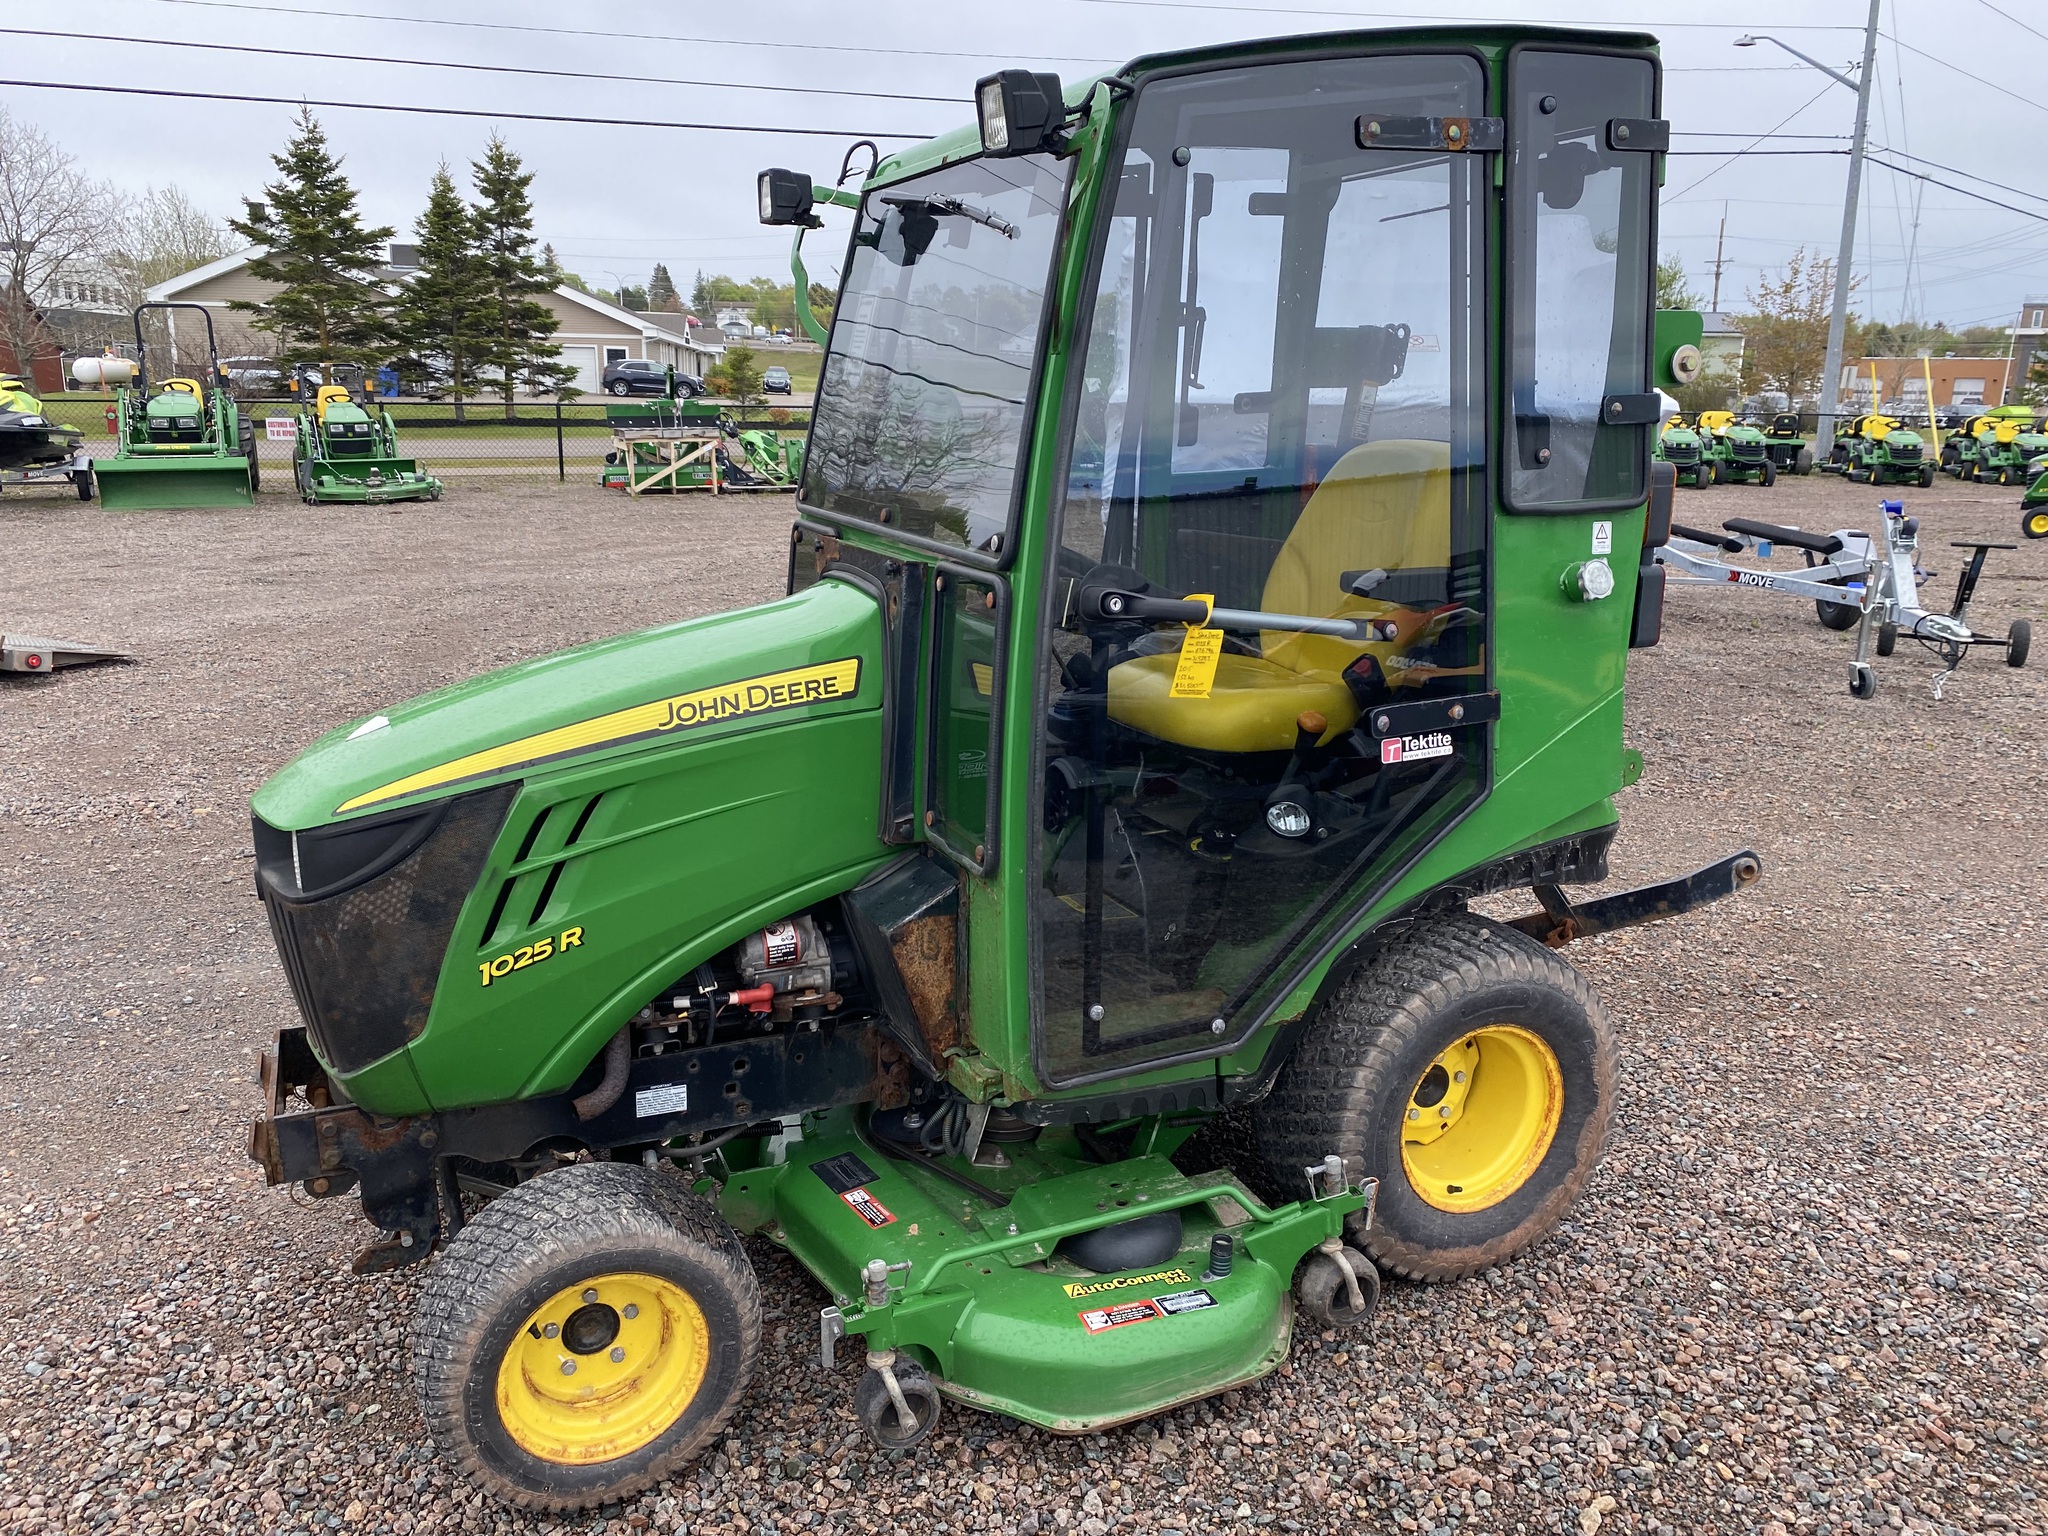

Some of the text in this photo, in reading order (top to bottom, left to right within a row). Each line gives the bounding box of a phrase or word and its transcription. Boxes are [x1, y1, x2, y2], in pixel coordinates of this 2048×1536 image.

[1738, 572, 1774, 588] MOVE
[658, 676, 840, 727] JOHN DEERE
[1402, 732, 1452, 751] Tektite
[479, 926, 583, 987] 1025 R
[1071, 1268, 1187, 1298] AutoConnect
[1165, 1275, 1192, 1286] 54D
